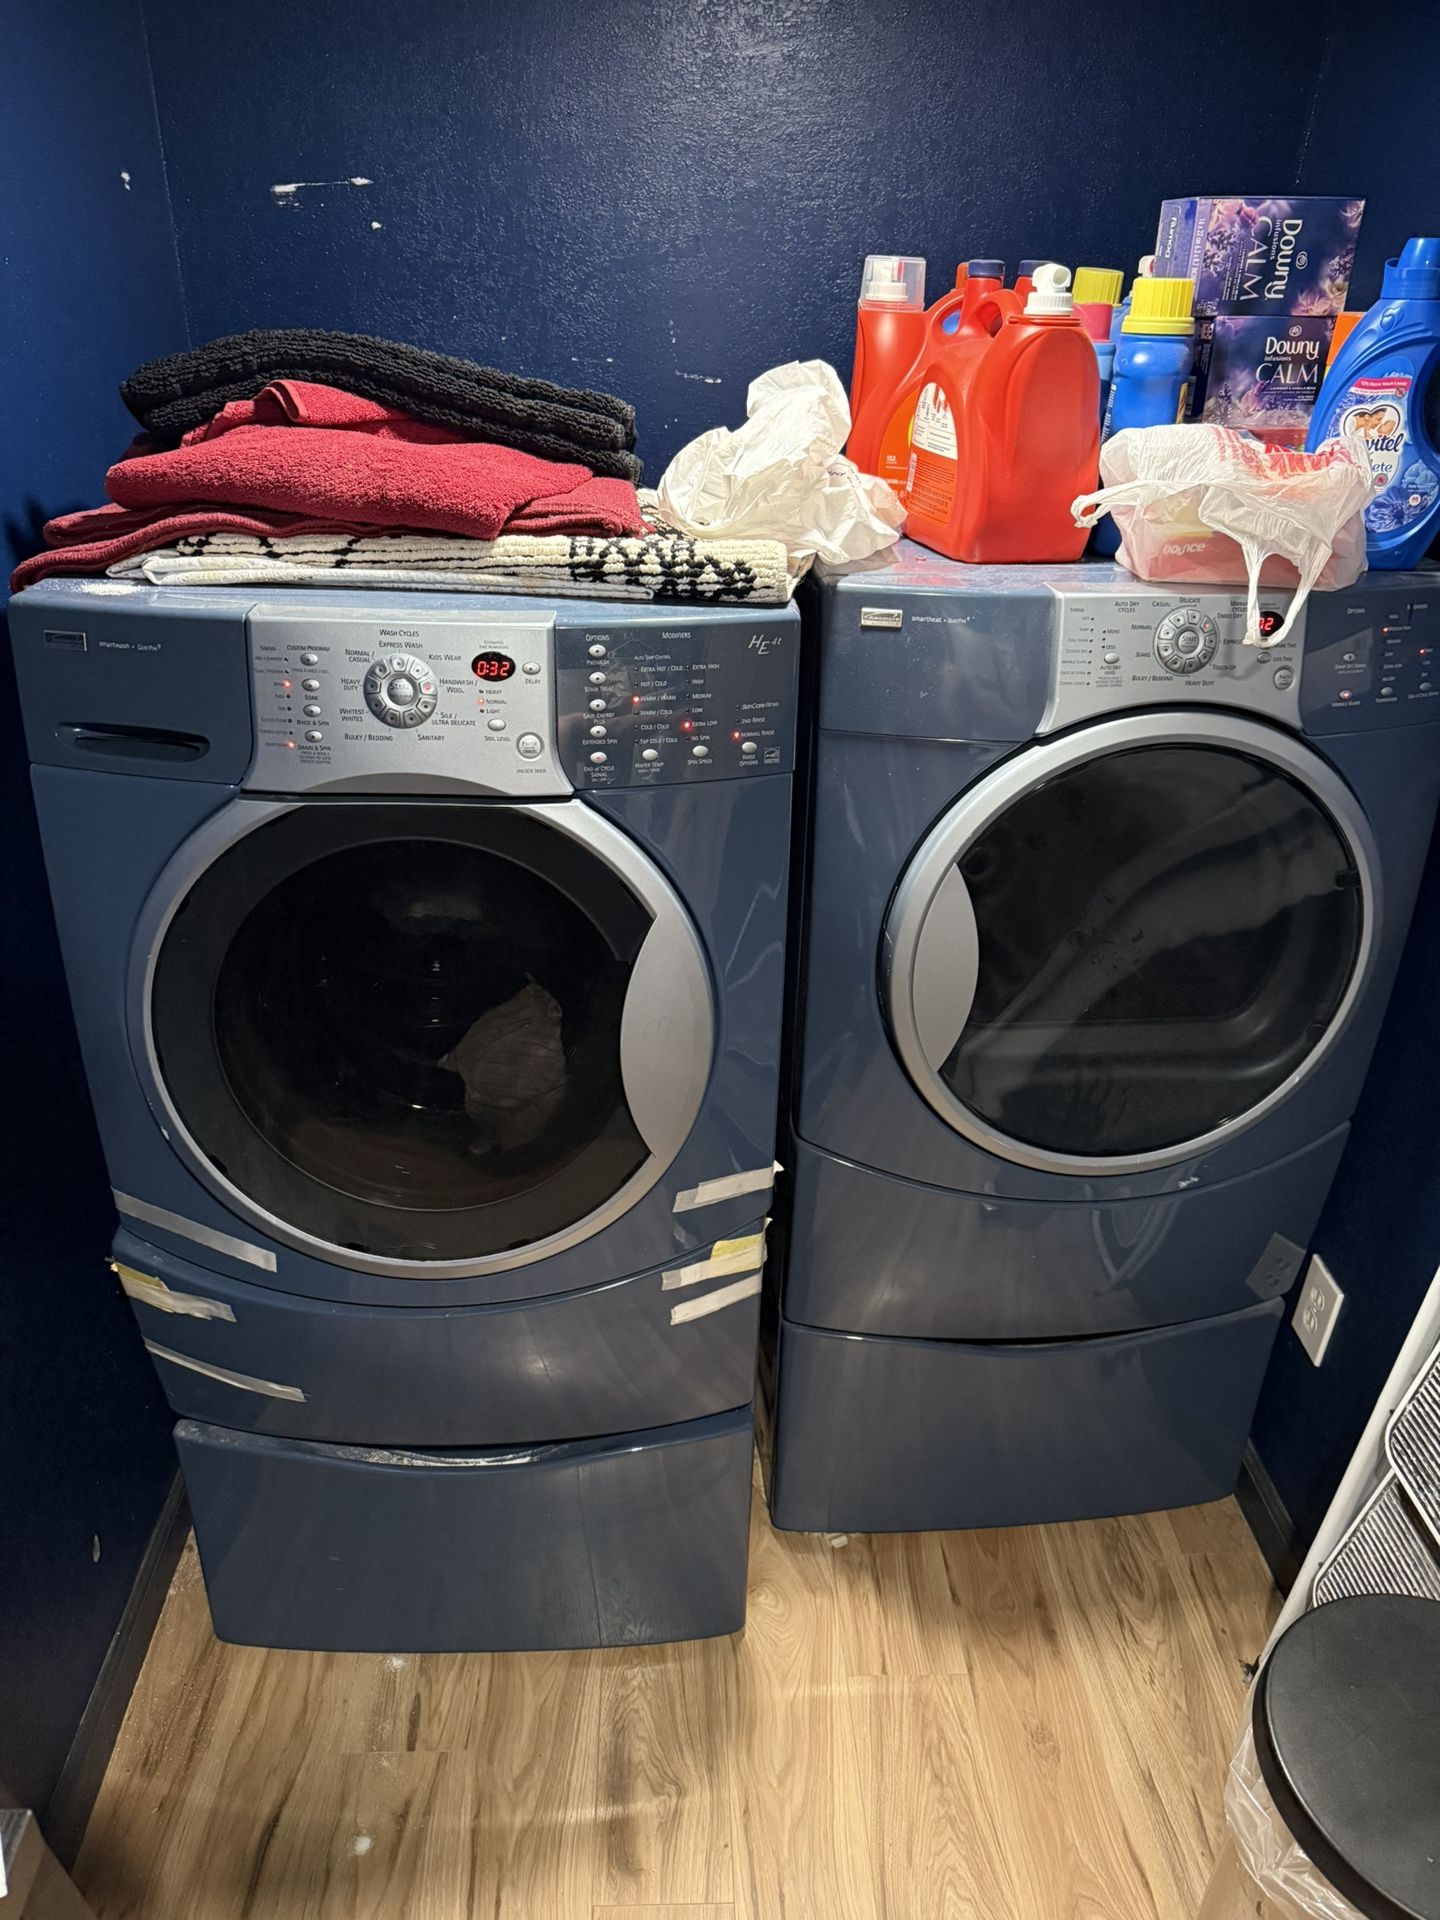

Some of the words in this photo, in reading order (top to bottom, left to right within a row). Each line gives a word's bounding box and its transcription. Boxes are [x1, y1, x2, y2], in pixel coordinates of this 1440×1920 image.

[1239, 216, 1273, 300] CALM
[1264, 219, 1303, 299] Downy
[1264, 336, 1320, 361] Downy
[1255, 362, 1318, 384] CALM
[1365, 432, 1404, 452] vitel
[399, 629, 420, 637] CYCLES
[345, 649, 371, 657] NORMAL
[477, 661, 510, 676] 0:32
